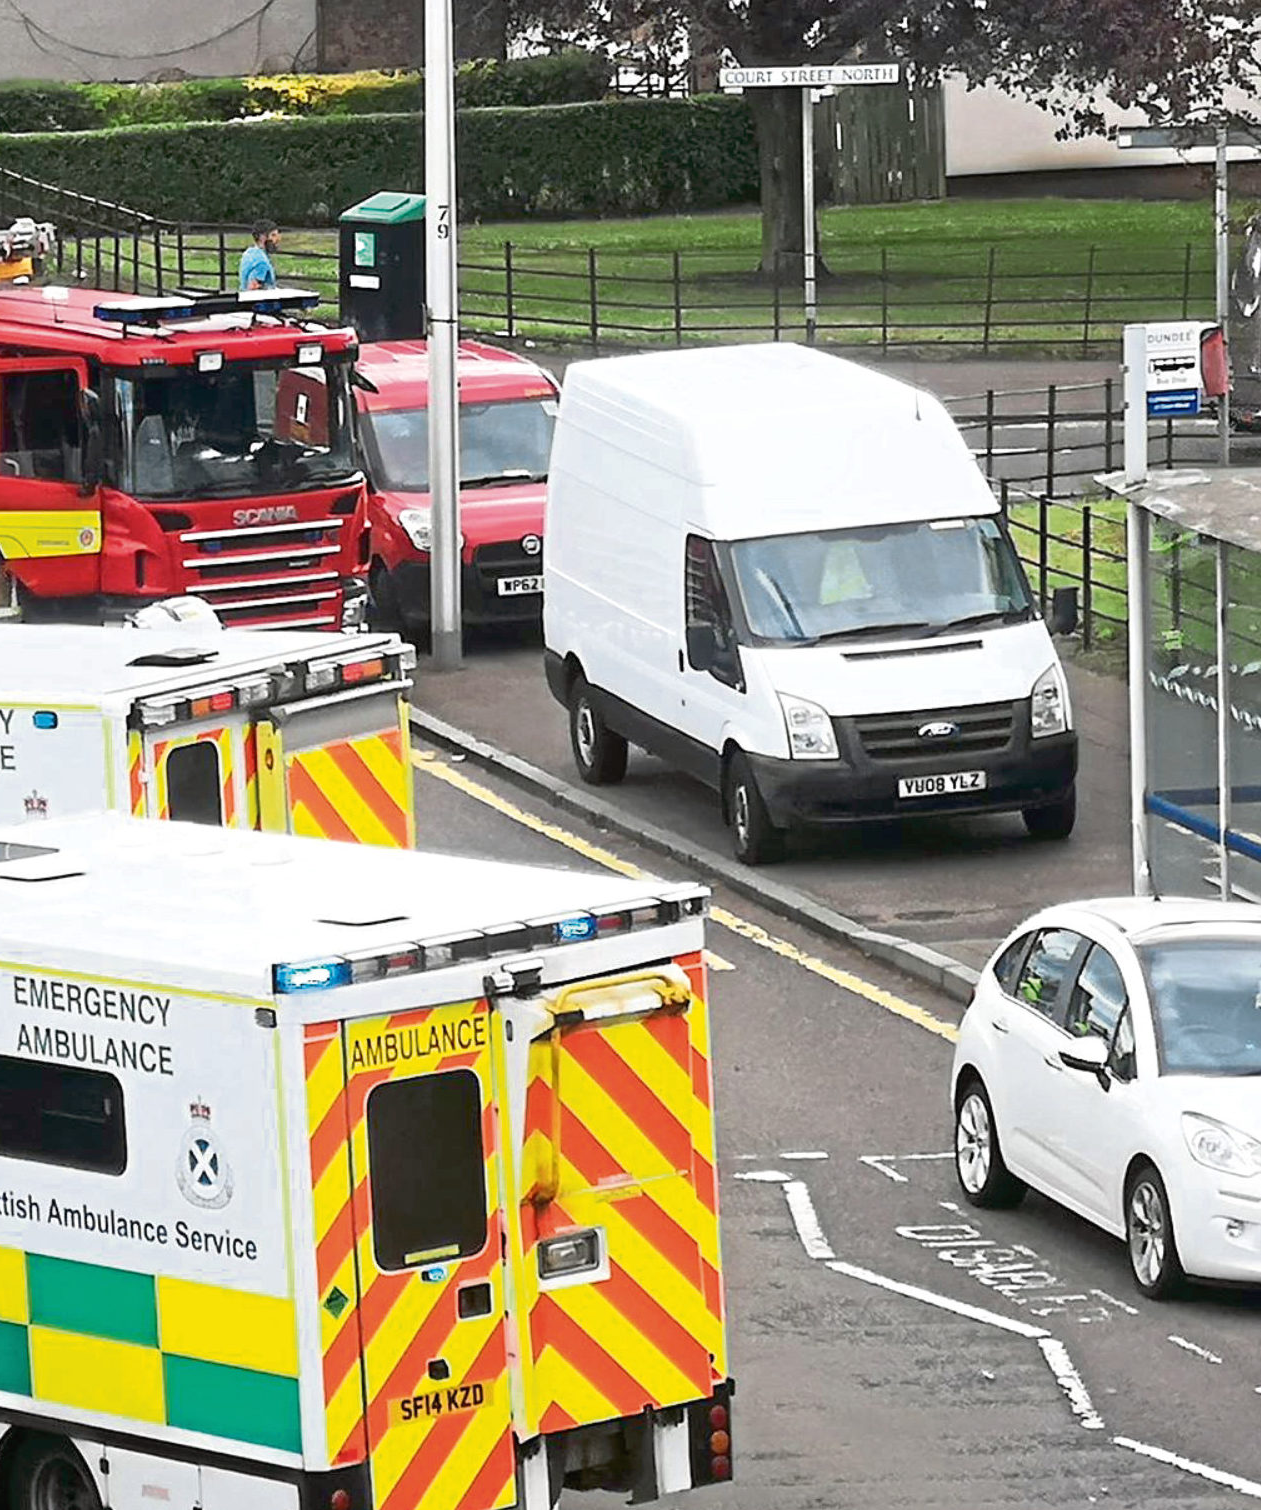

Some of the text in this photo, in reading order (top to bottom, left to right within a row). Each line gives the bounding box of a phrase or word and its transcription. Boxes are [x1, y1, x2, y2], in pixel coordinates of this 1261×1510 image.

[725, 68, 893, 84] COURT STREET NORTH
[1147, 332, 1191, 344] DUNDEE
[233, 504, 298, 526] SCANIA
[950, 773, 980, 789] YLZ
[13, 976, 171, 1027] EMERGENCY
[17, 1023, 174, 1076] AMBULANCE
[352, 1017, 486, 1070] AMBULANCE
[47, 1198, 168, 1245] Ambulance
[175, 1221, 258, 1260] Service
[401, 1383, 484, 1421] SF14 KZD
